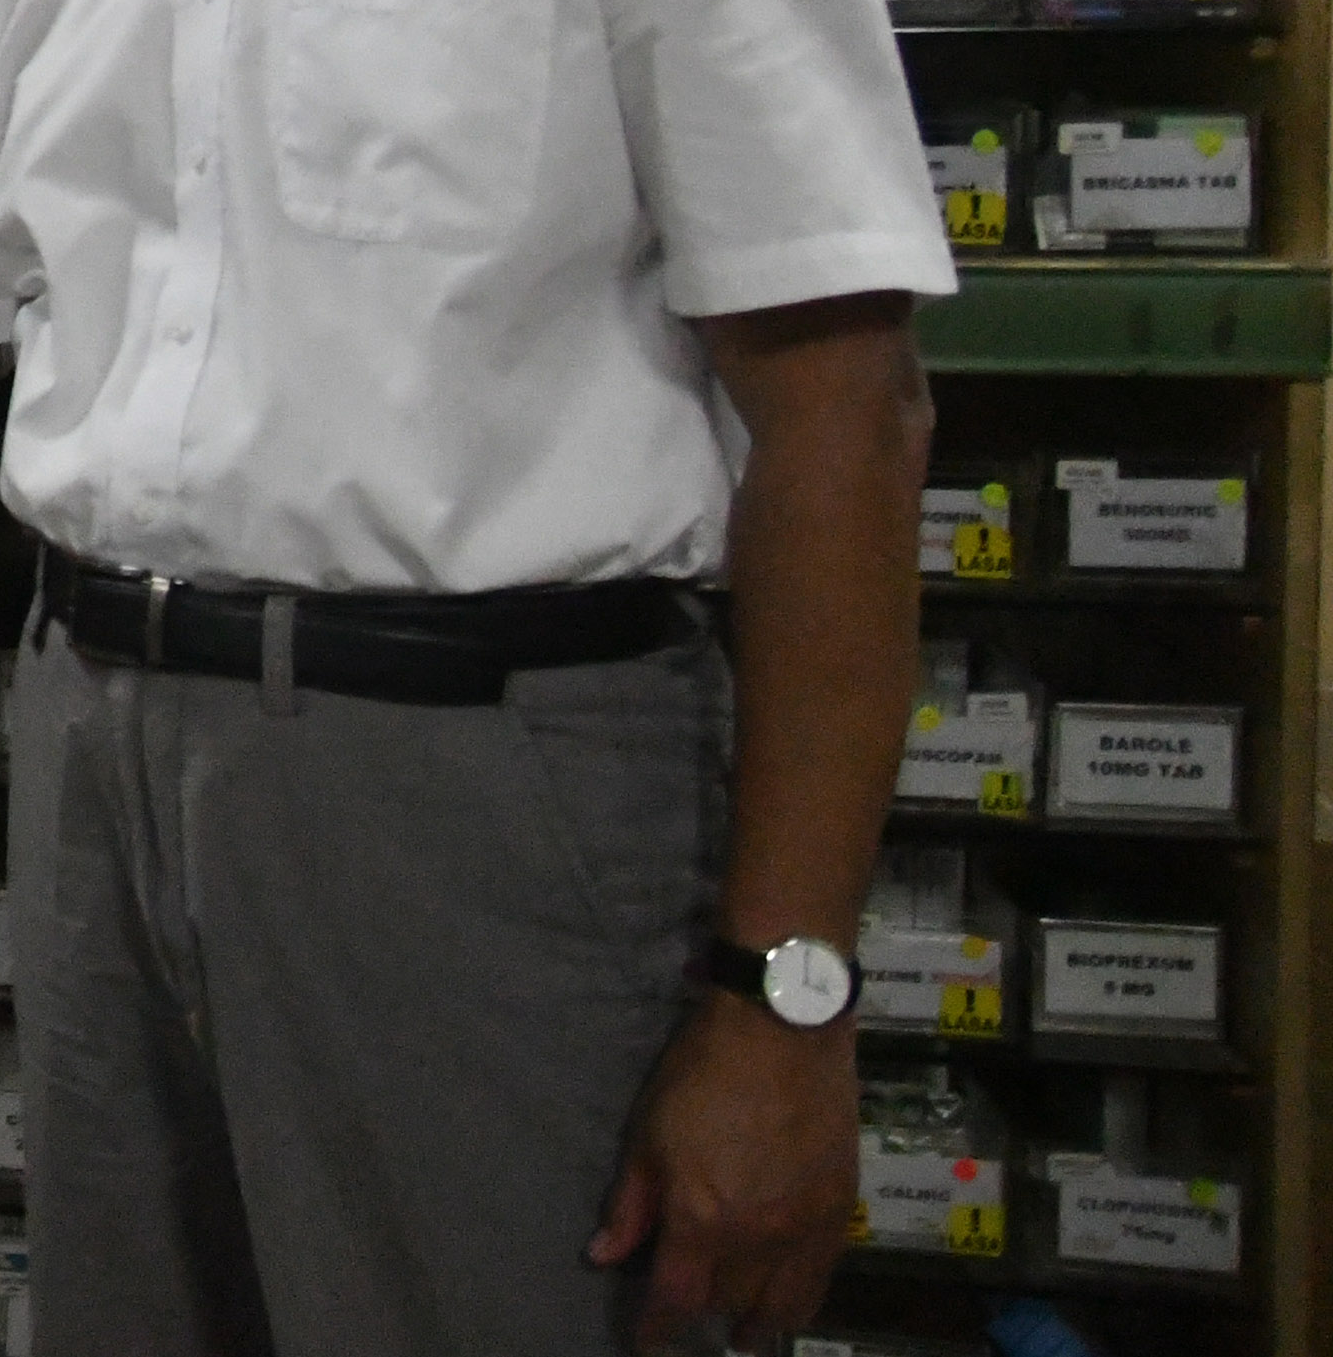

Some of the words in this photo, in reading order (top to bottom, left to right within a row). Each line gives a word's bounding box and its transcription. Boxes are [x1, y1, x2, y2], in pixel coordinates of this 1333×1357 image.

[1082, 175, 1191, 192] BRICASMA
[1197, 174, 1238, 190] TAB
[1098, 735, 1193, 753] BAROLE
[906, 748, 1003, 765] USCOPAN
[1157, 762, 1204, 780] TAB
